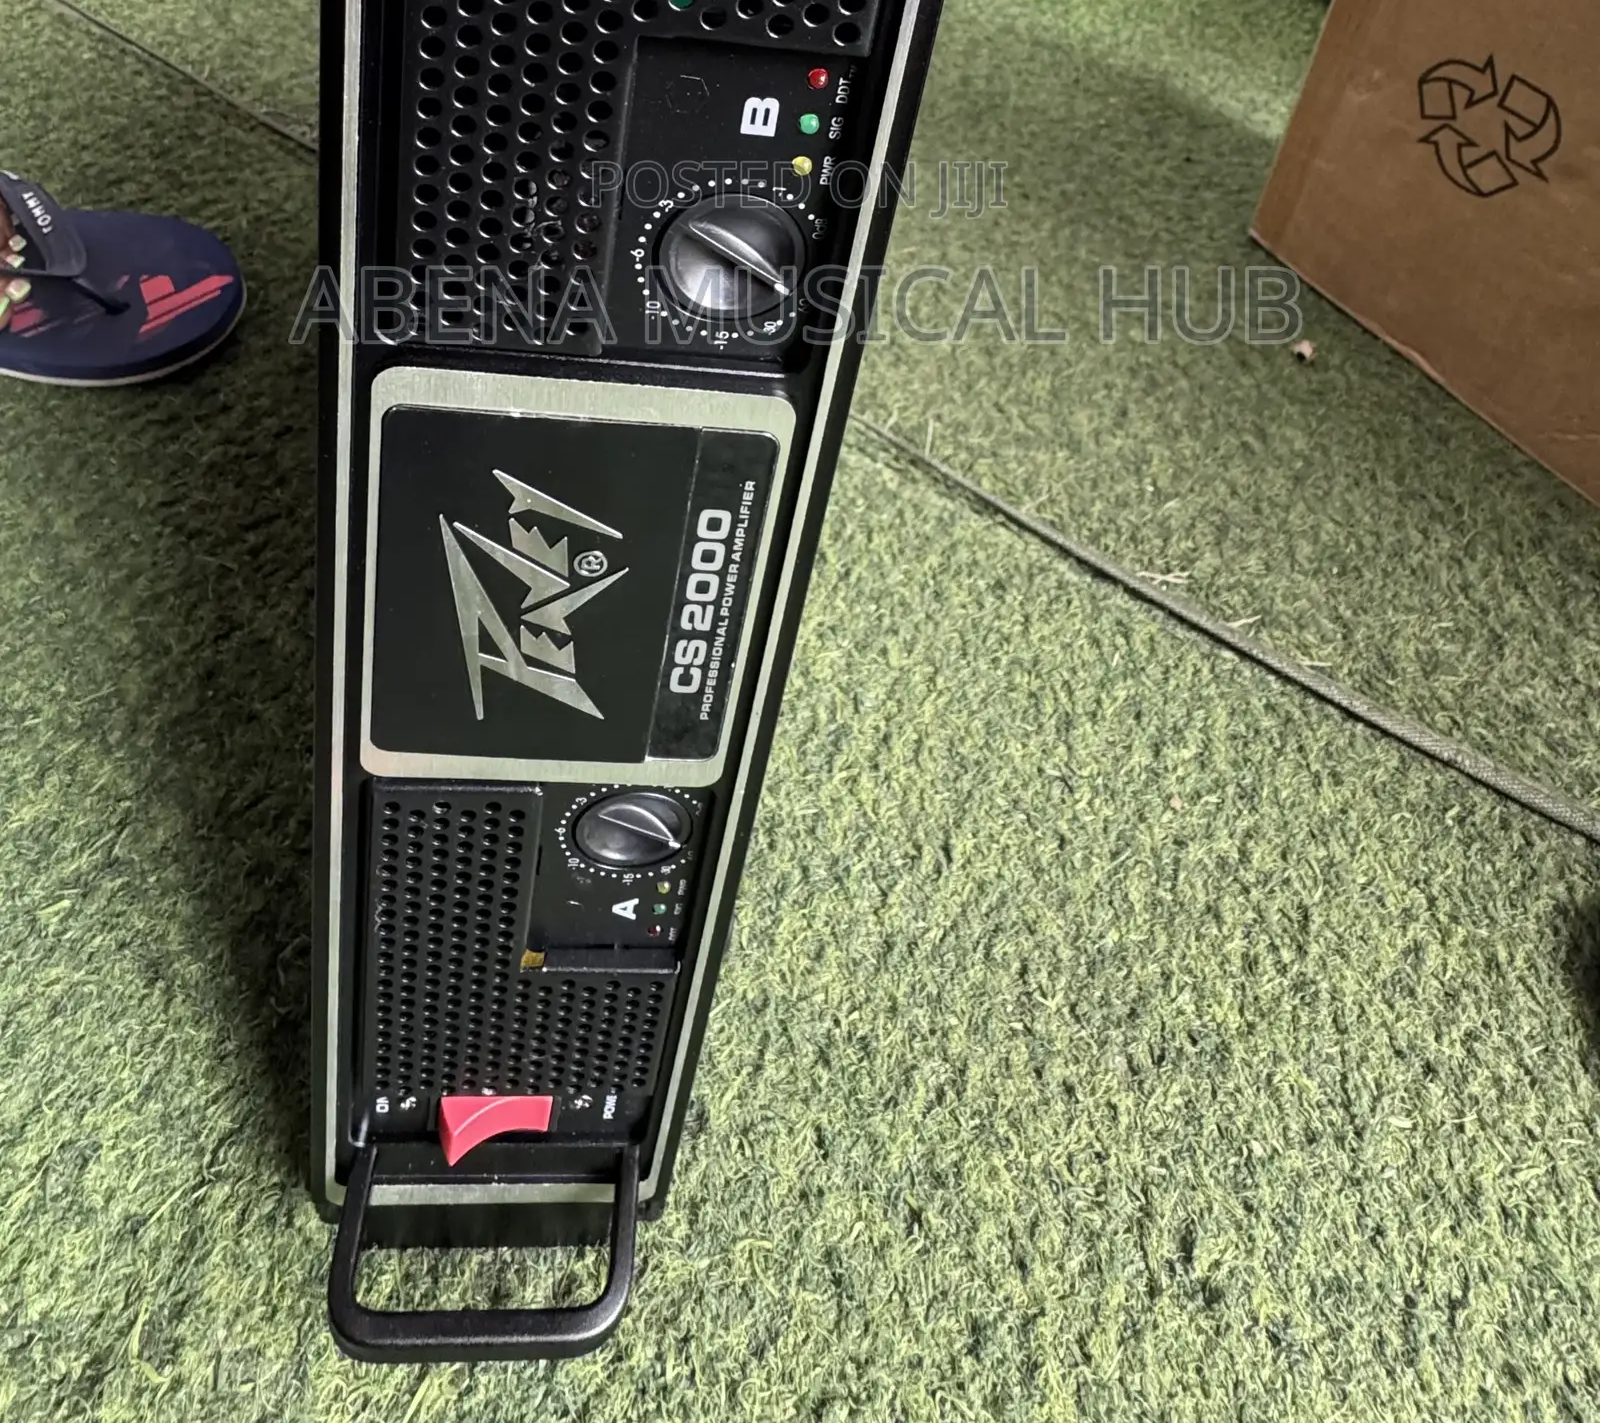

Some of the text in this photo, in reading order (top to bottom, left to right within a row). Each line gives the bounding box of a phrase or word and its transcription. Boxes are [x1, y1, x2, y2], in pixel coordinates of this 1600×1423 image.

[835, 77, 850, 104] DDT
[740, 96, 780, 137] B
[828, 116, 845, 140] SIG
[819, 155, 836, 186] PWR
[20, 190, 54, 234] TOMMY
[658, 198, 674, 213] -3
[630, 248, 645, 263] -6
[645, 300, 662, 321] -10
[714, 330, 730, 351] -15
[438, 468, 630, 721] PEAVEY
[669, 509, 732, 694] CS 2000
[700, 480, 756, 720] PROFESSIONAL POWER AMPLIFIER
[611, 897, 640, 921] A
